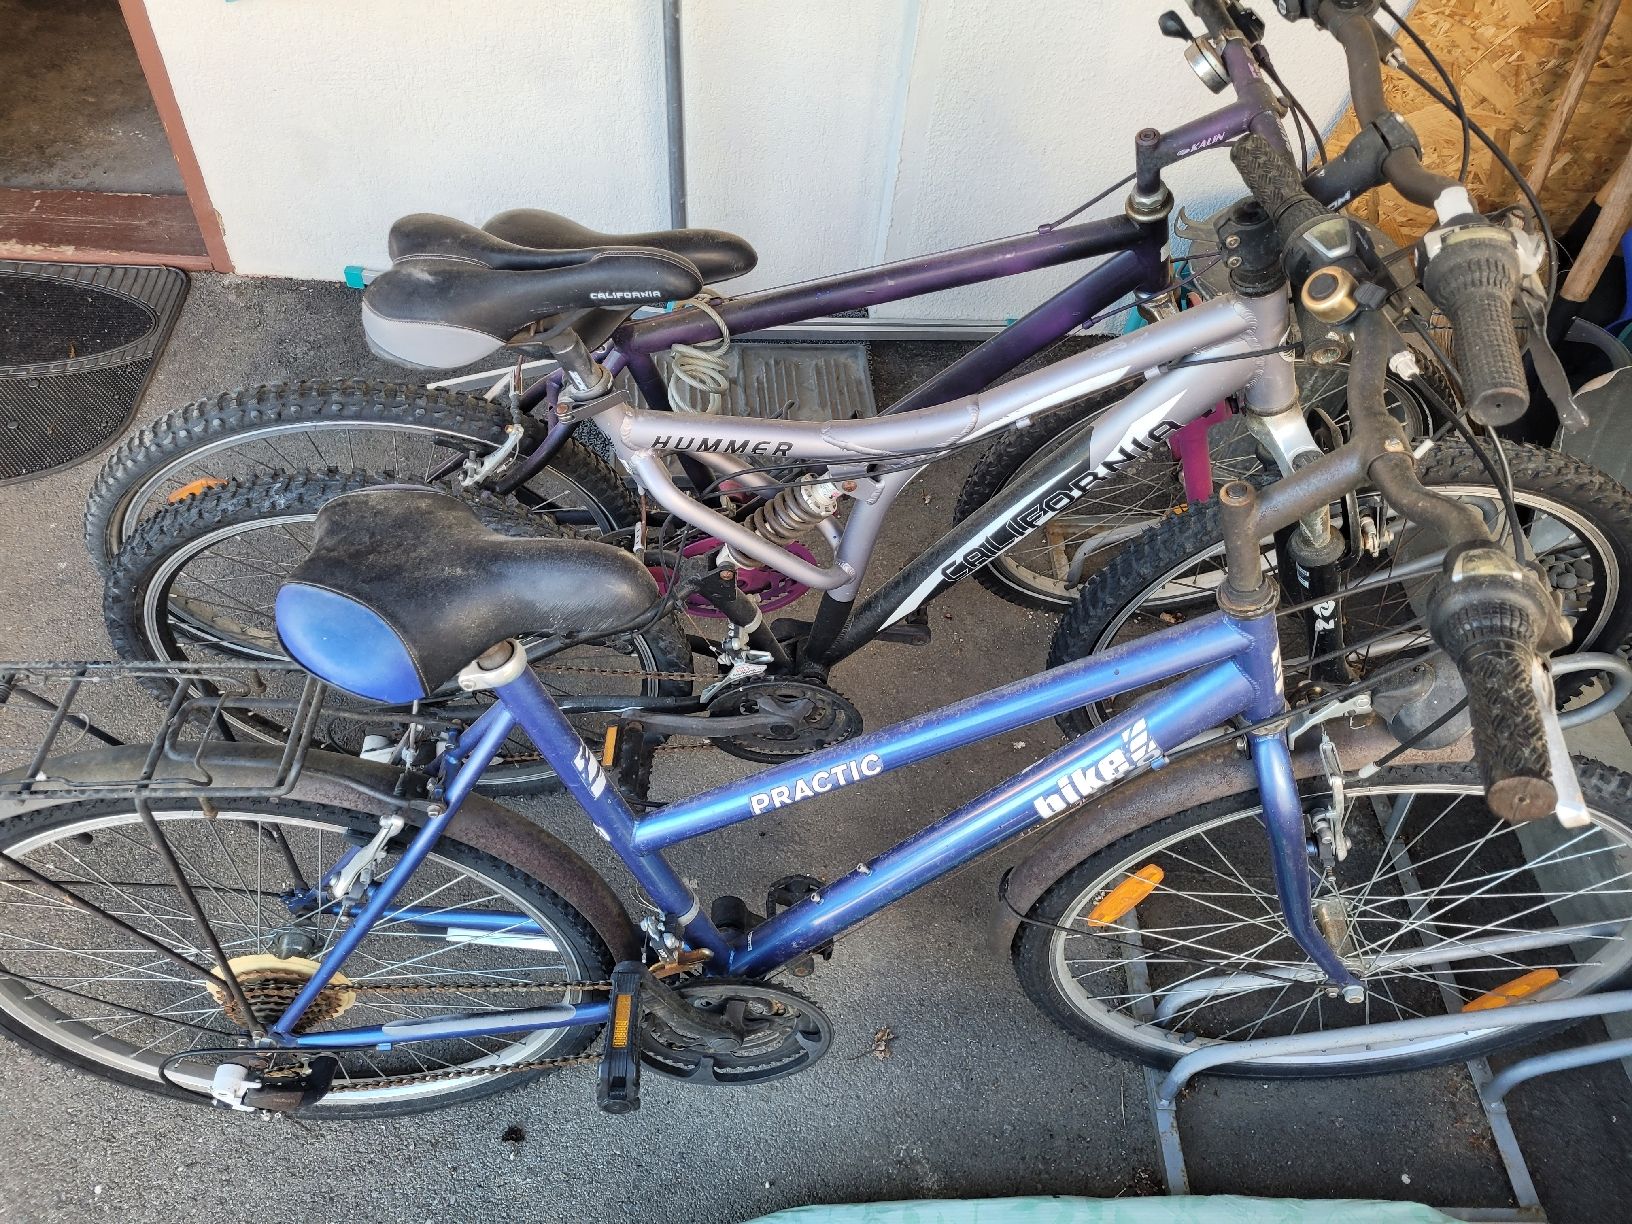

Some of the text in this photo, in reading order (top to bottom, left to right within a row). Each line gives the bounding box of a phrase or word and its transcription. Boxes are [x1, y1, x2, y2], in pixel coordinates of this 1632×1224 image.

[589, 290, 662, 300] CALIFORNIA
[651, 435, 795, 457] HUMMER
[941, 419, 1186, 582] CALIFORNIA
[750, 752, 883, 816] PRACTIC
[1033, 748, 1131, 819] bike
